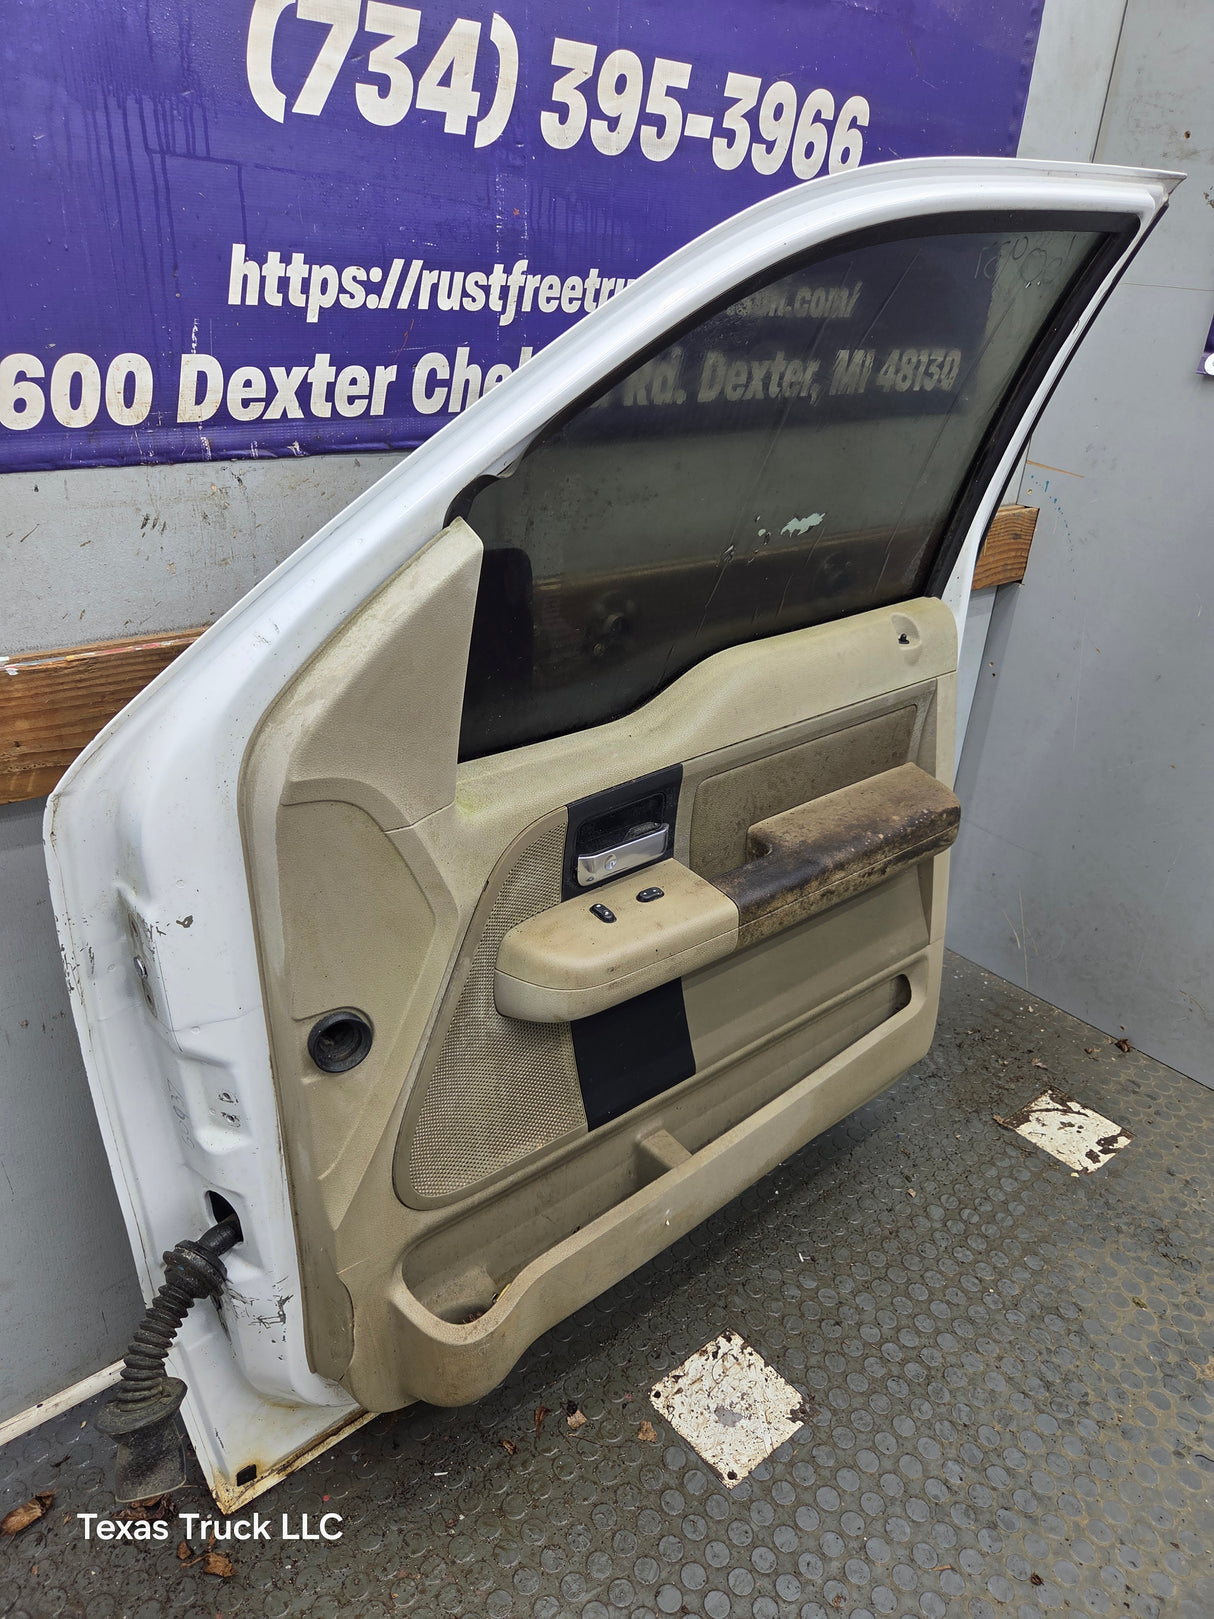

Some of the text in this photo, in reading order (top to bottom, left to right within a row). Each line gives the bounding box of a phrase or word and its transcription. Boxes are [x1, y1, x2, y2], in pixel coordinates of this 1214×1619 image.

[247, 0, 870, 180] (734) 395-3966
[0, 353, 154, 430] 600
[177, 353, 397, 423] Dexter
[412, 347, 534, 415] Che
[696, 349, 823, 408] Dexter,
[828, 349, 874, 396] MI
